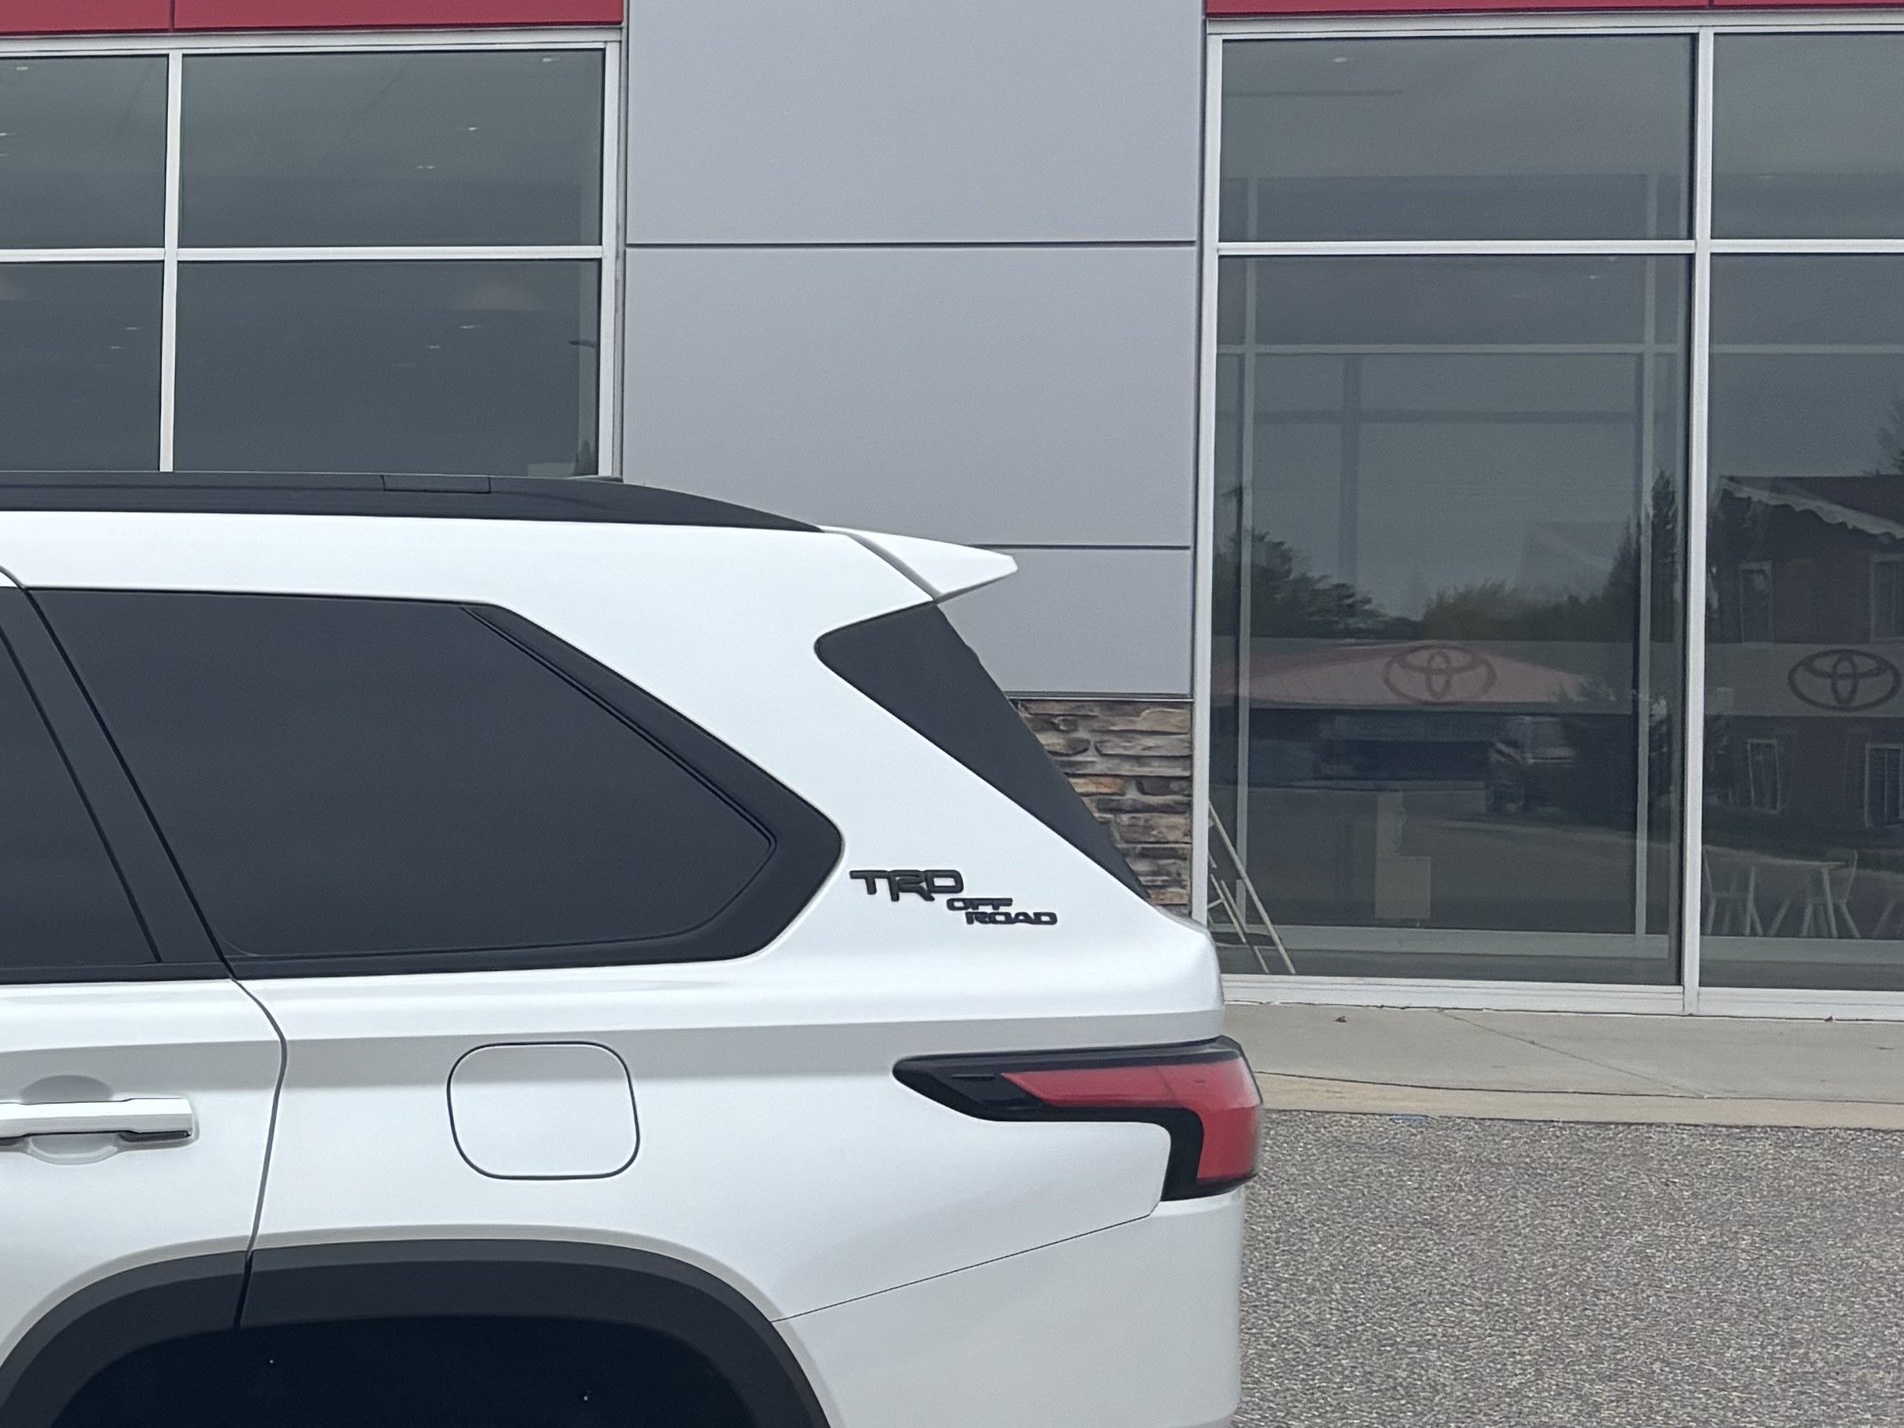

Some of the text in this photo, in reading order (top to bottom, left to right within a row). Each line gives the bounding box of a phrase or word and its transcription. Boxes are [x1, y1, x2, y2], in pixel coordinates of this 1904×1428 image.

[849, 870, 964, 902] TRD
[946, 898, 1013, 911] OFF
[965, 911, 1058, 925] ROAD
